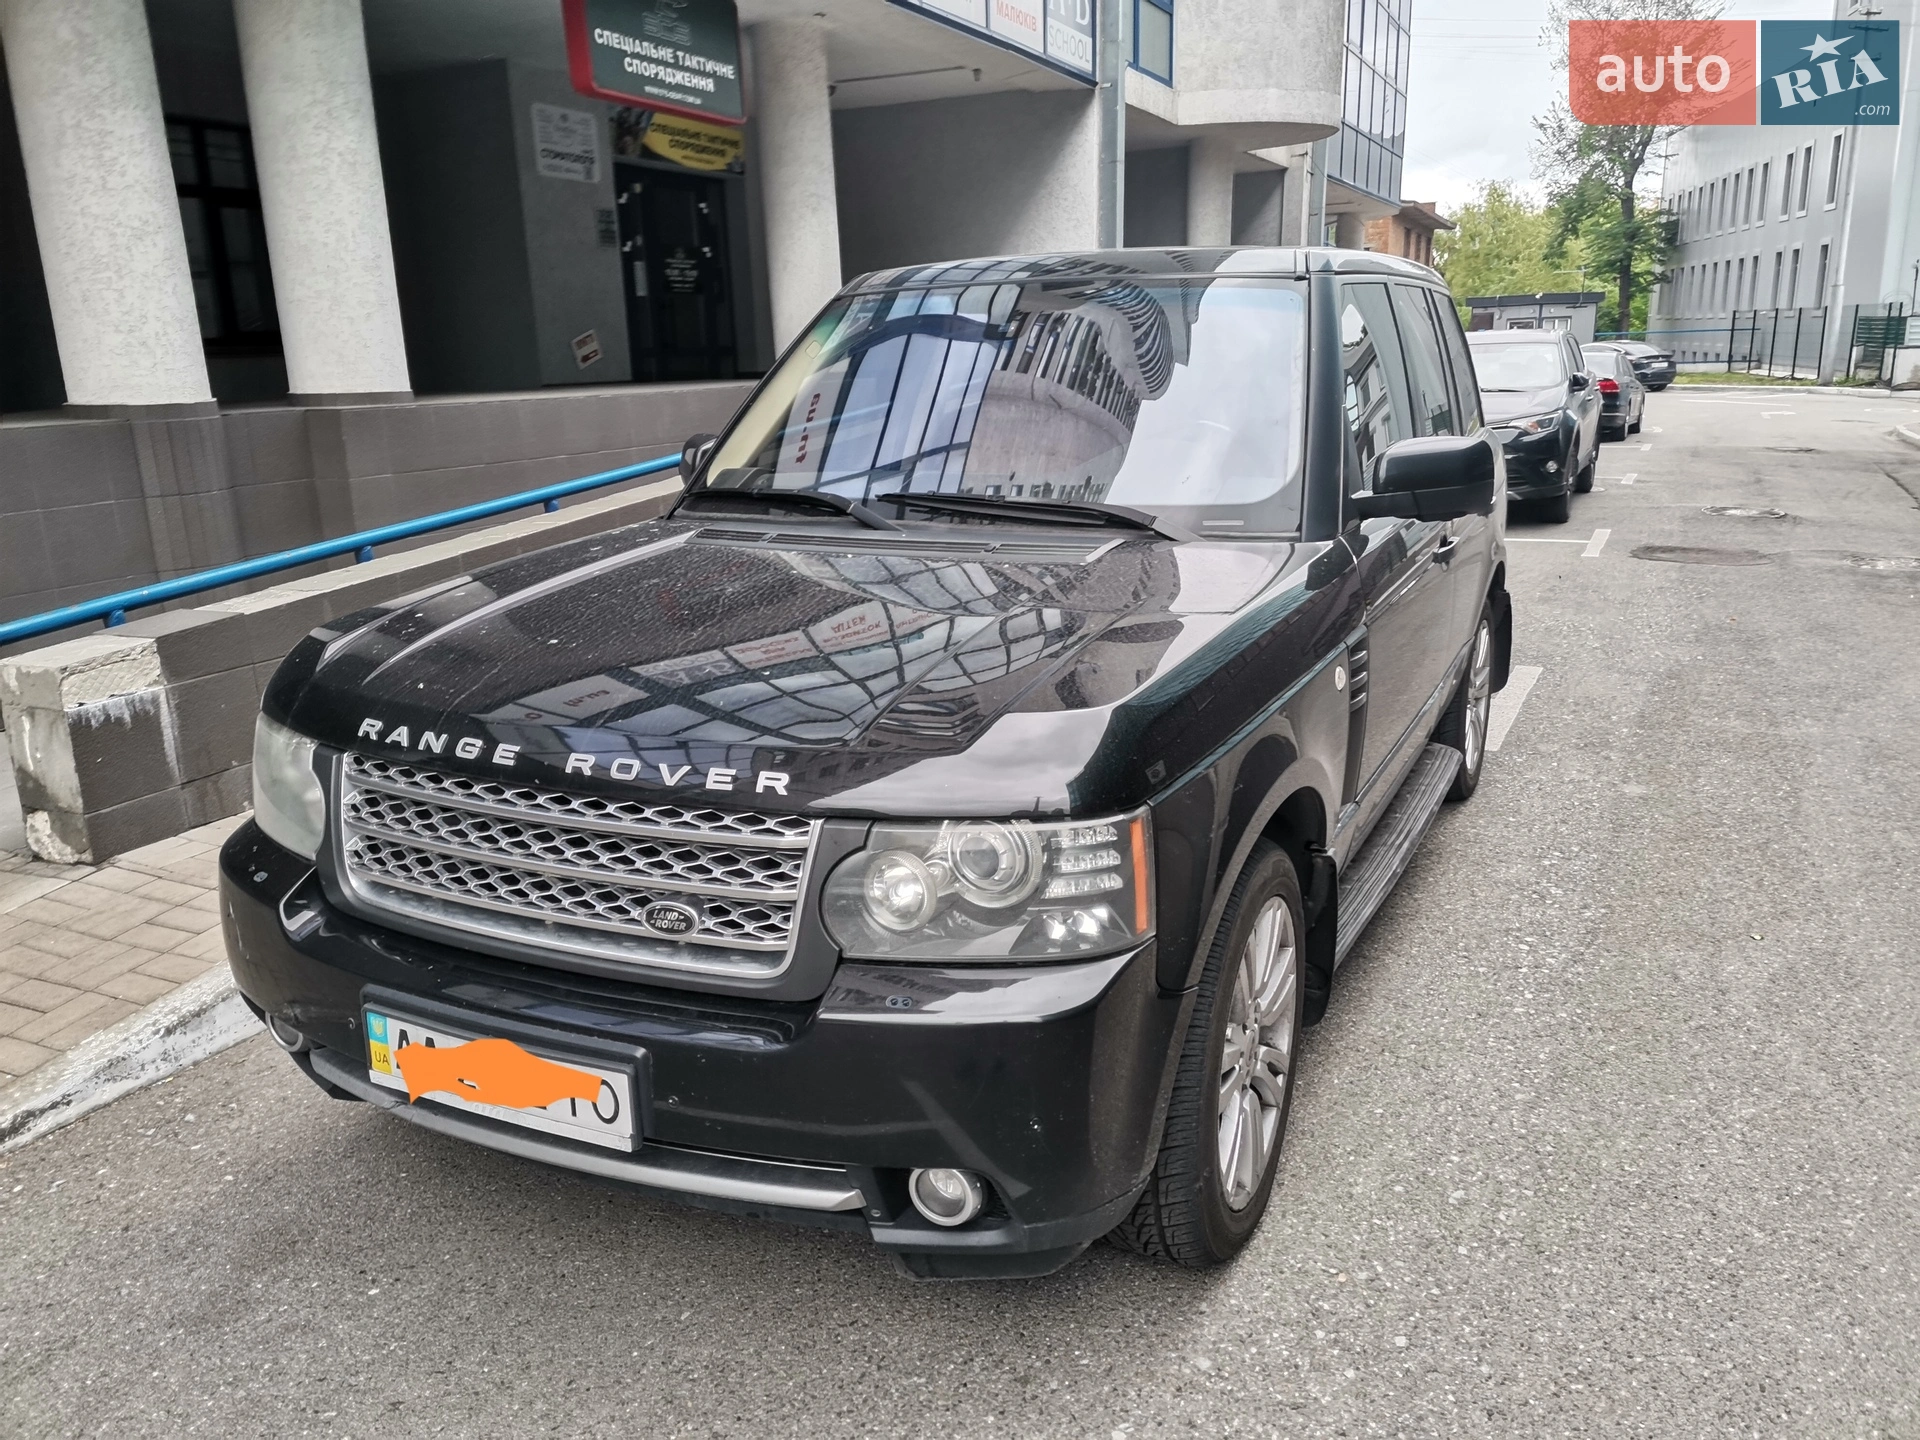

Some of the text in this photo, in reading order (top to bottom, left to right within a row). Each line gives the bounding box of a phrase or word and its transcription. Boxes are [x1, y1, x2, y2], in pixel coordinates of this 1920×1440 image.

[996, 2, 1037, 32] МАЛЮКІВ
[593, 27, 735, 80] СПЕЦІАЛЬНЕ ТАКТИЧНЕ
[1048, 24, 1090, 64] SCHOOL
[624, 57, 715, 93] СПОРЯДЖЕННЯ
[357, 718, 790, 796] RANGE ROVER
[652, 909, 679, 920] LAND
[654, 920, 687, 931] ROVER
[374, 1050, 390, 1066] UA
